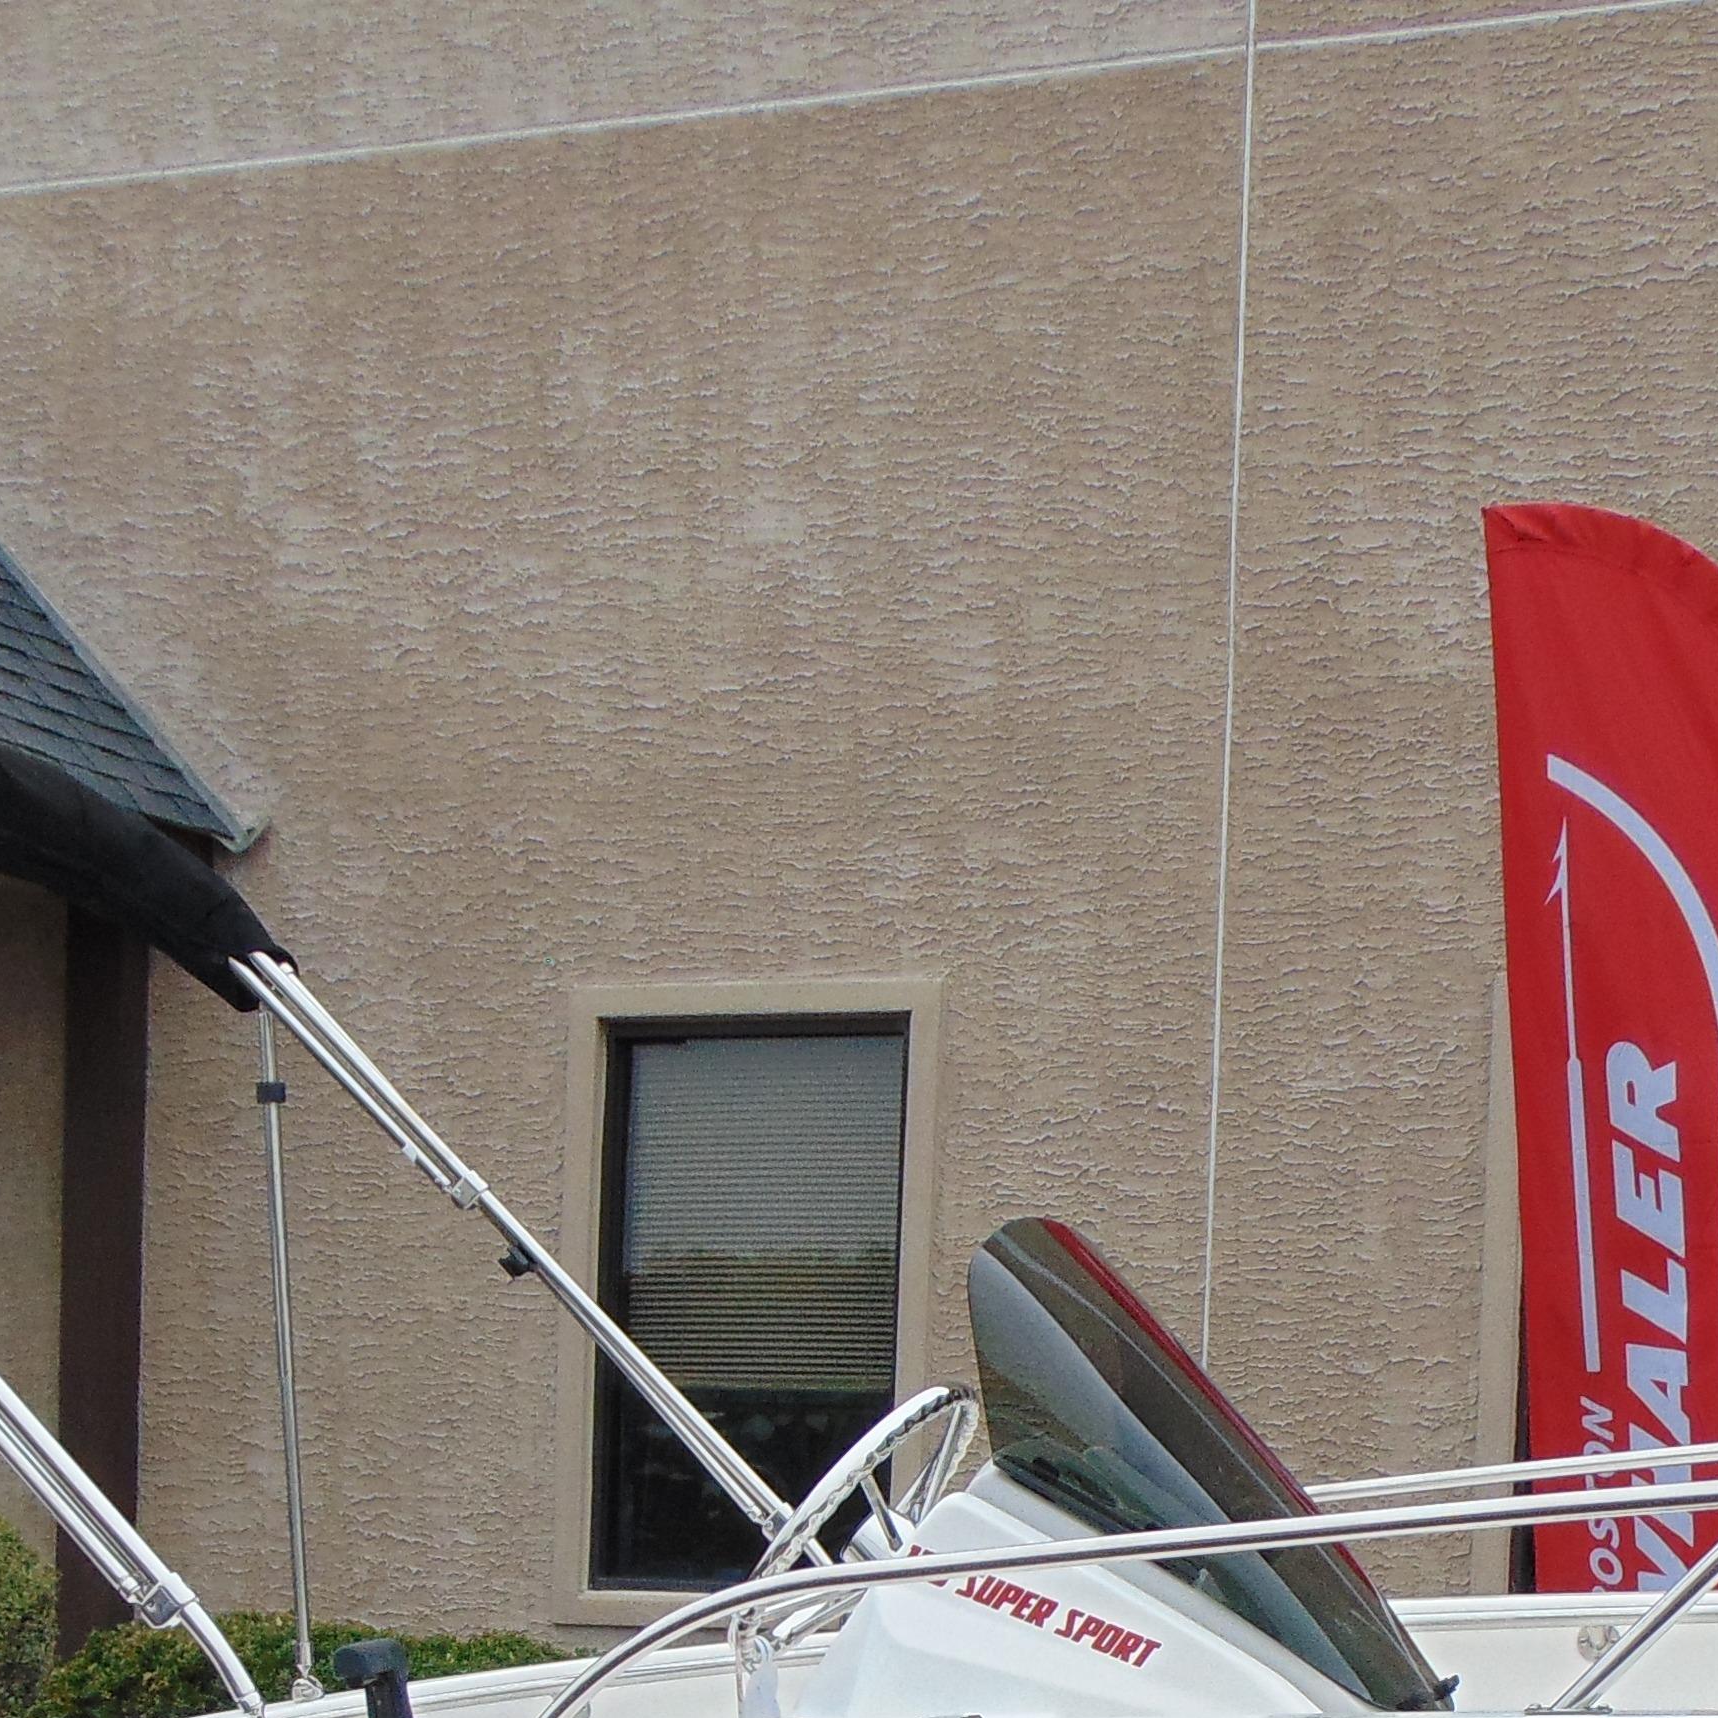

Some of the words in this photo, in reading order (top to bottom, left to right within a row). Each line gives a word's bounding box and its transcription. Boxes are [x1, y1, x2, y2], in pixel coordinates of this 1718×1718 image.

[1580, 1396, 1623, 1593] OSON
[955, 1575, 1059, 1628] SUPER
[1054, 1609, 1161, 1668] SPORT
